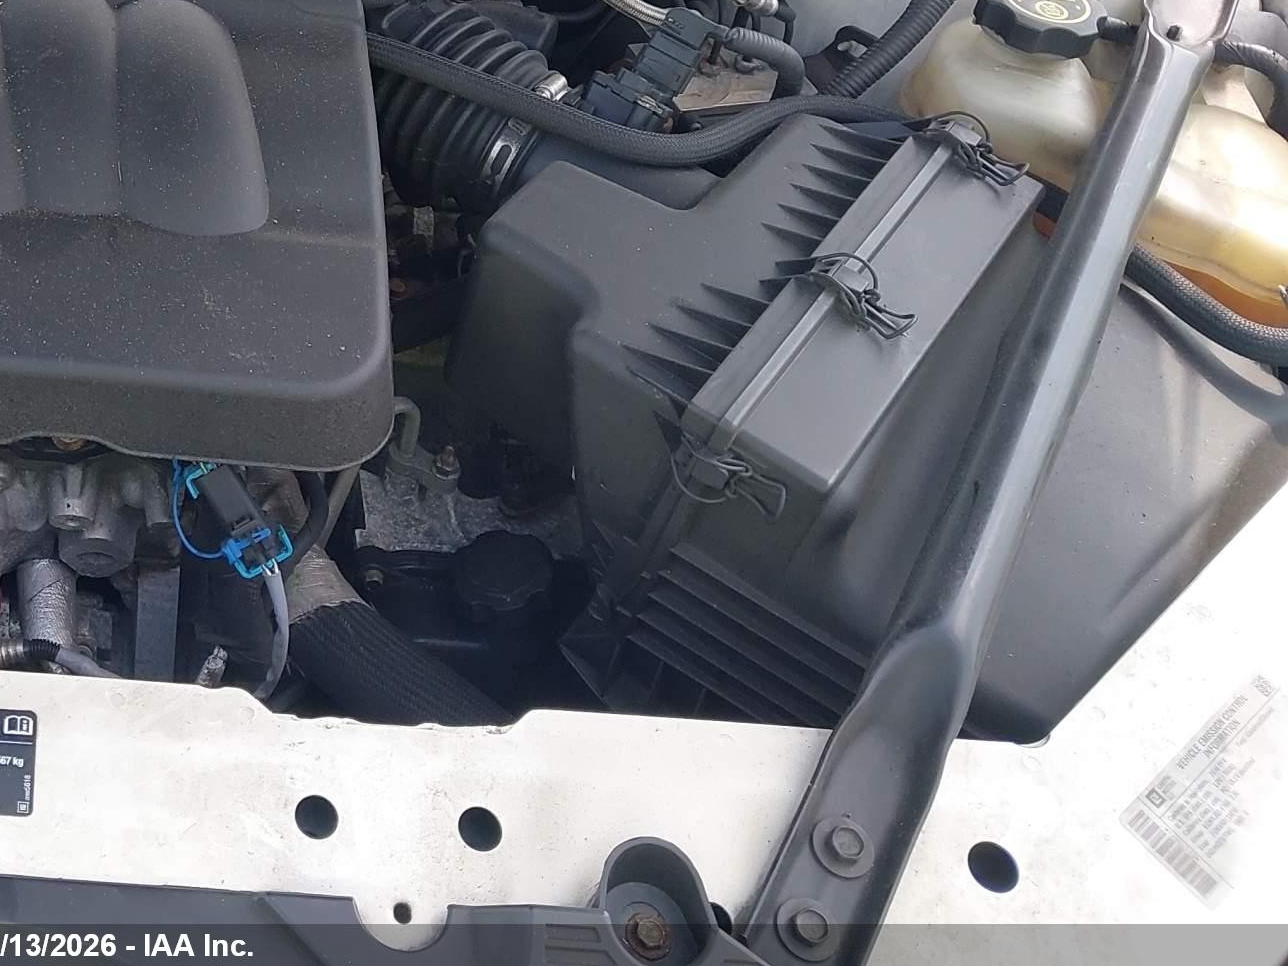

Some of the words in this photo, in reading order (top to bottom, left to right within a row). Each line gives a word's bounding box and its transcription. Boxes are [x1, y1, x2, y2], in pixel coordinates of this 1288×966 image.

[1176, 743, 1202, 770] VEHICLE
[1197, 718, 1226, 747] EMISSION
[1222, 694, 1248, 721] CONTROL
[1202, 719, 1241, 758] INFORMATION
[12, 755, 24, 767] kg
